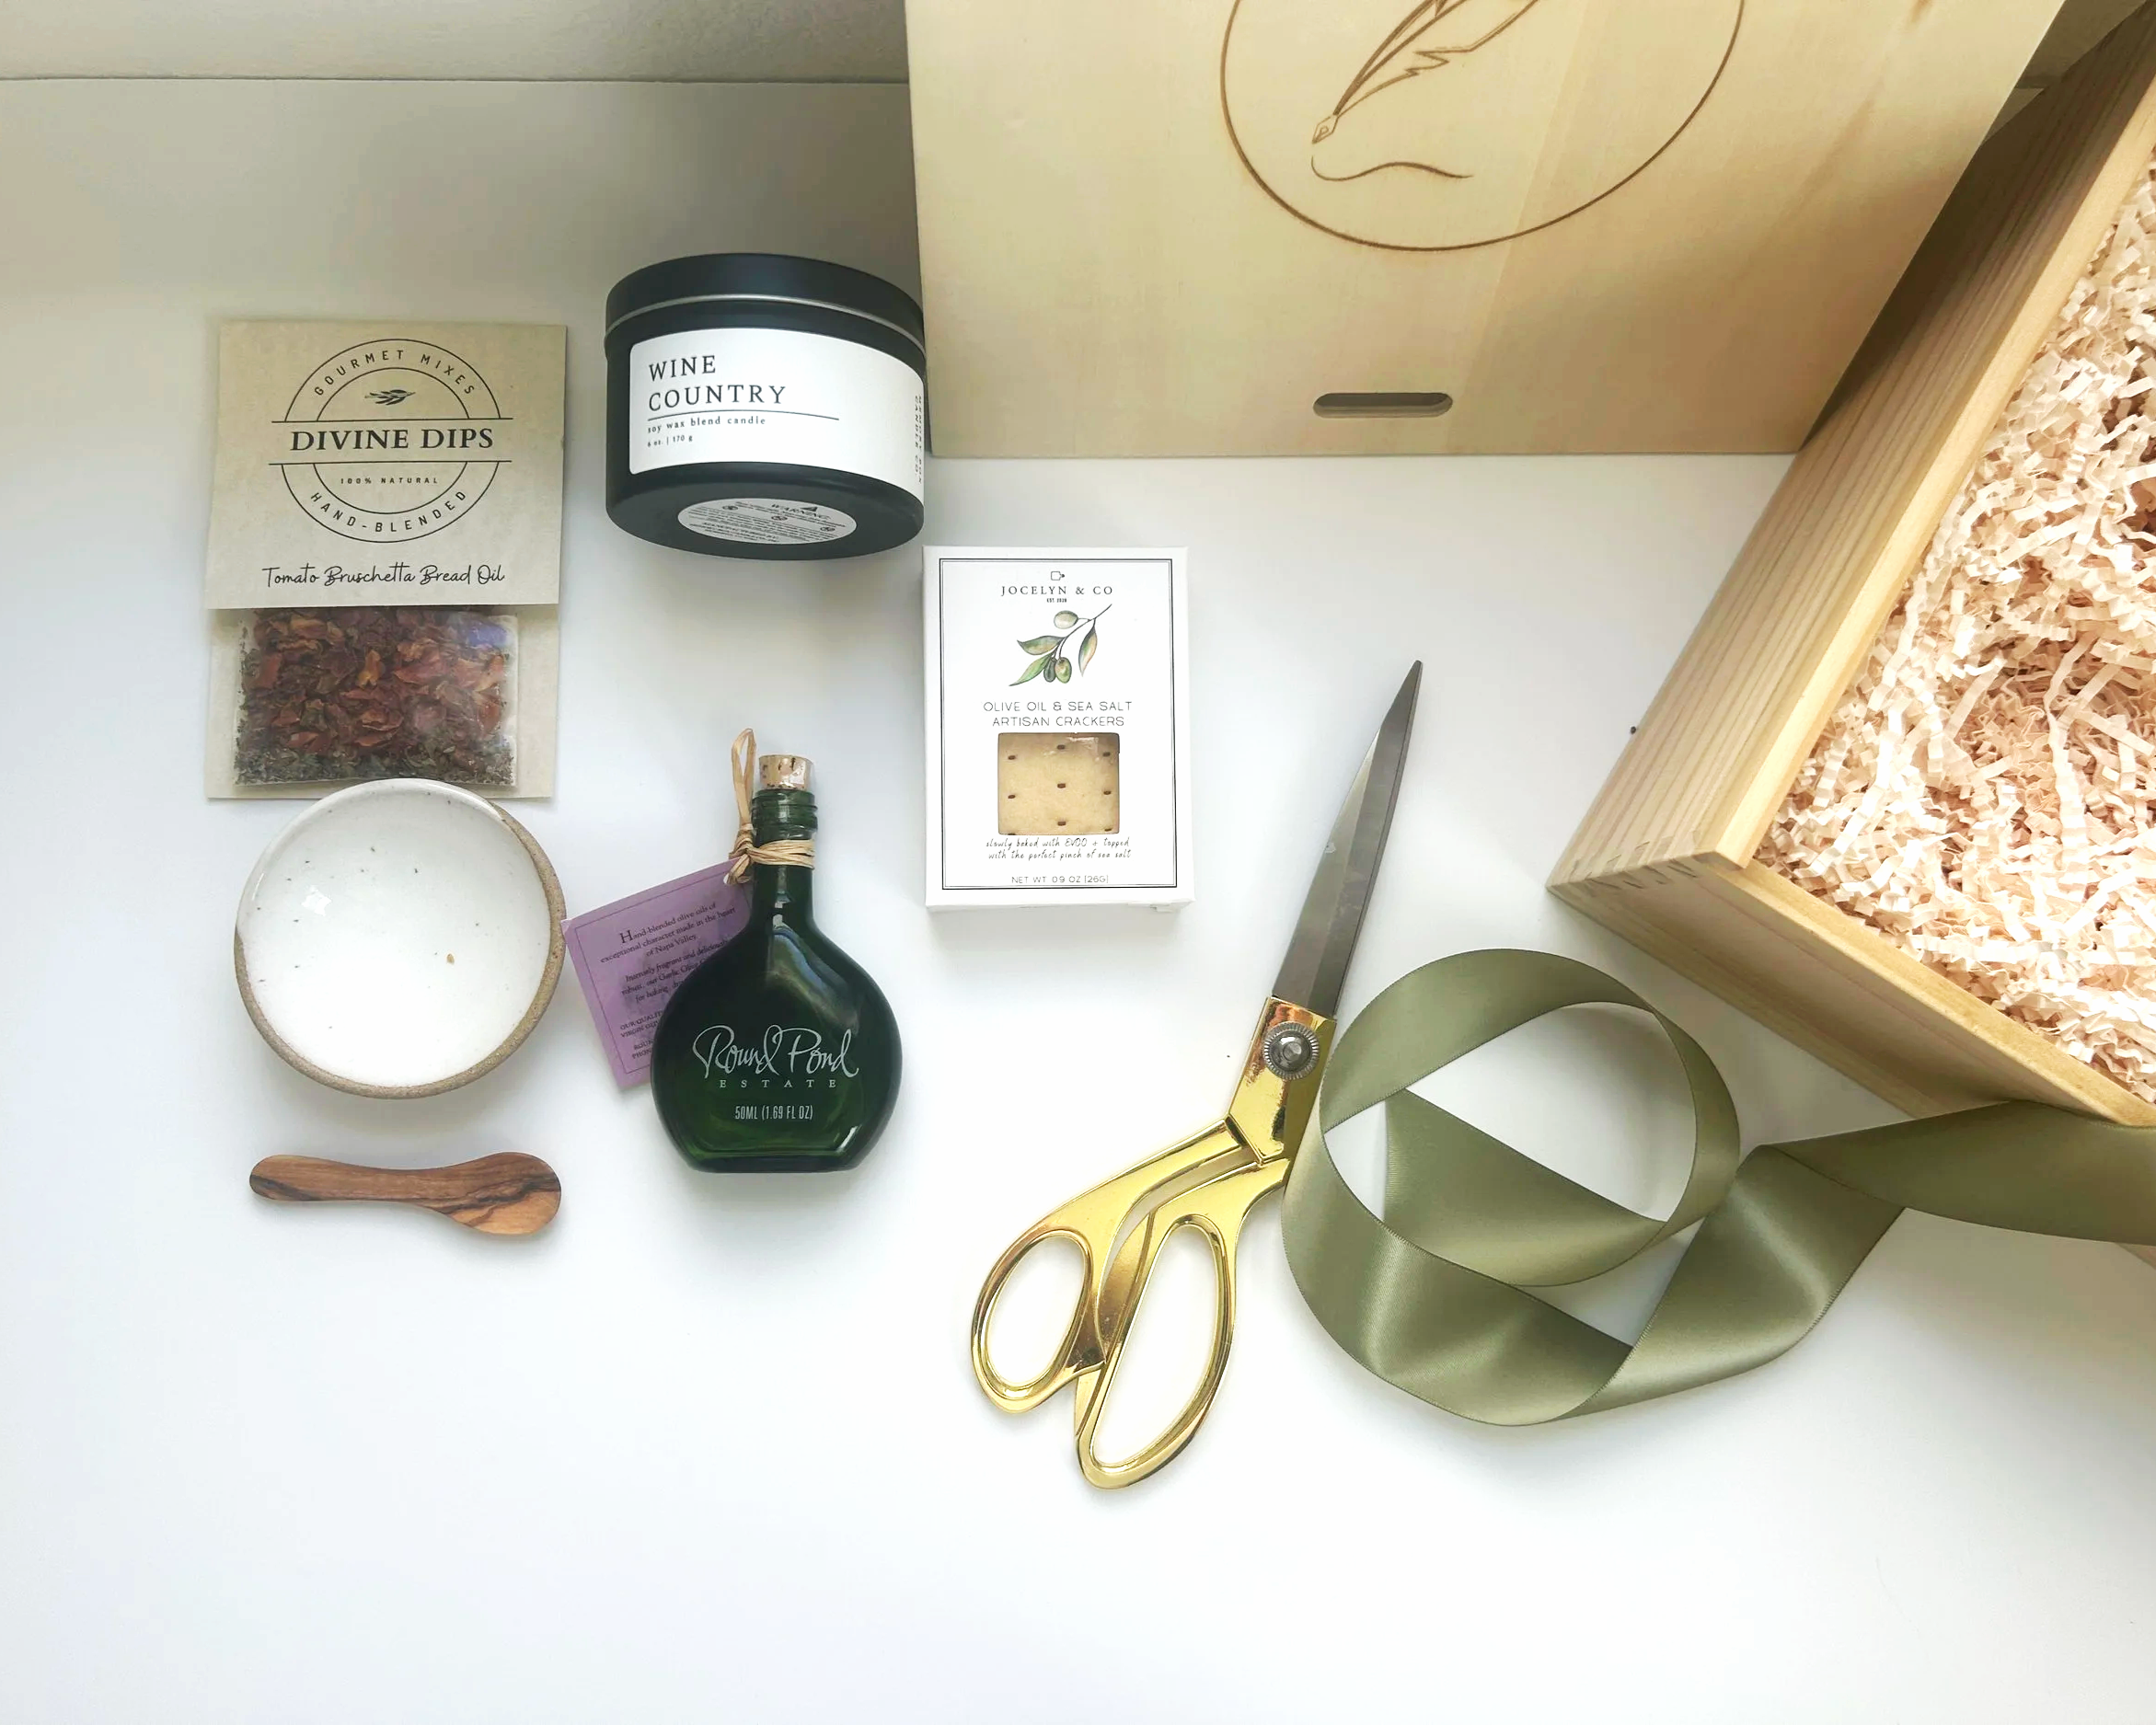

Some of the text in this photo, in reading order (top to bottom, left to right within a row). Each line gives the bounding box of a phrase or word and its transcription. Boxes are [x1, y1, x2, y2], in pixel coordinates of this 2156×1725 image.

[315, 350, 475, 397] GOURMET MIXES
[649, 355, 716, 382] WINE
[649, 385, 786, 411] COUNTRY
[648, 425, 662, 433] soy
[690, 416, 721, 426] blend
[727, 416, 766, 424] candle
[291, 428, 494, 451] DIVINE DIPS
[340, 477, 439, 485] 100% NATURAL
[311, 490, 466, 533] HAND-BLENDED
[262, 562, 505, 587] Tomato Bruschetta Bread Oil
[1000, 586, 1113, 596] JOCELYN & CO
[984, 701, 1133, 712] OLIVE OIL & SEA SALT
[993, 717, 1124, 727] ARTISAN CRACKERS
[986, 838, 1012, 850] slowly
[1016, 837, 1039, 847] baked
[1043, 837, 1060, 846] with
[1065, 838, 1087, 846] EVOO
[1103, 837, 1130, 849] topped
[988, 850, 1007, 859] with
[1011, 850, 1024, 859] the
[1029, 849, 1057, 861] perfect
[1060, 849, 1082, 861] pinch
[1087, 848, 1097, 858] of
[1115, 849, 1131, 858] salt
[619, 903, 717, 944] Hand-blended olive oils of
[600, 943, 641, 963] exceptional
[643, 930, 674, 947] character
[676, 924, 695, 934] made
[705, 915, 716, 924] the
[717, 907, 736, 919] heart
[646, 949, 654, 958] of
[655, 942, 675, 955] Napa
[626, 966, 655, 983] Intensely
[656, 957, 682, 972] fragrant
[683, 949, 696, 960] and
[620, 1021, 635, 1030] OUR
[692, 1024, 859, 1078] Round Pond
[720, 1079, 836, 1088] ESTATE
[735, 1105, 813, 1120] 50ML (1.69 FL OZ)
